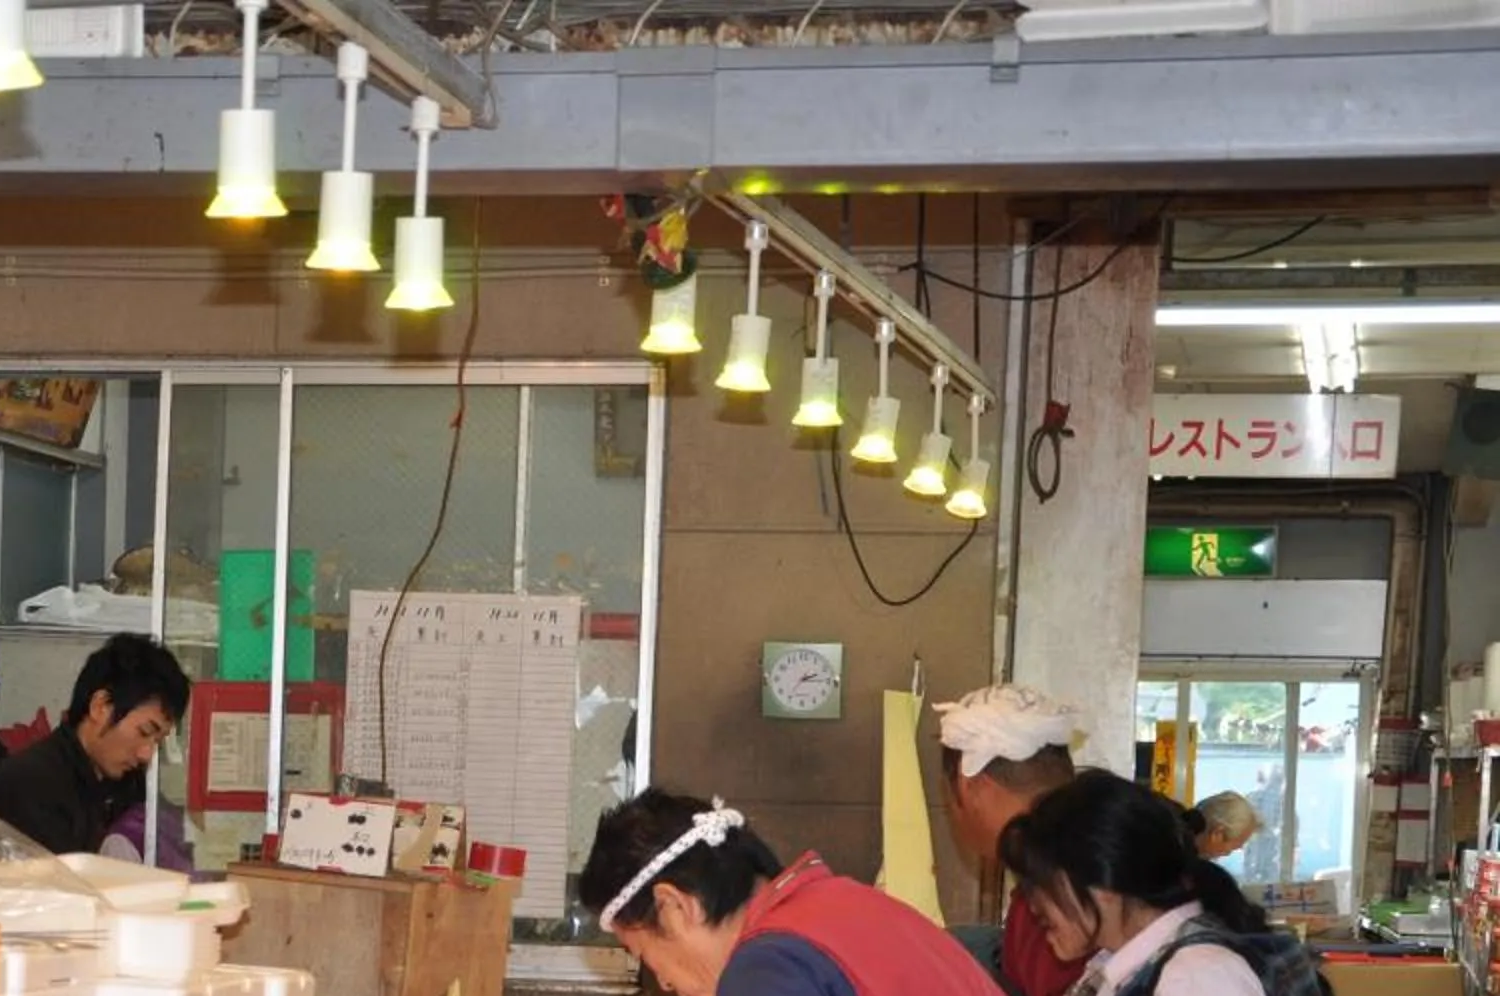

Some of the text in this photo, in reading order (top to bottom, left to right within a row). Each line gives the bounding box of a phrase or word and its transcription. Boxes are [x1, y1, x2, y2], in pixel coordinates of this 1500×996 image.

[1150, 418, 1383, 460] レストラン口
